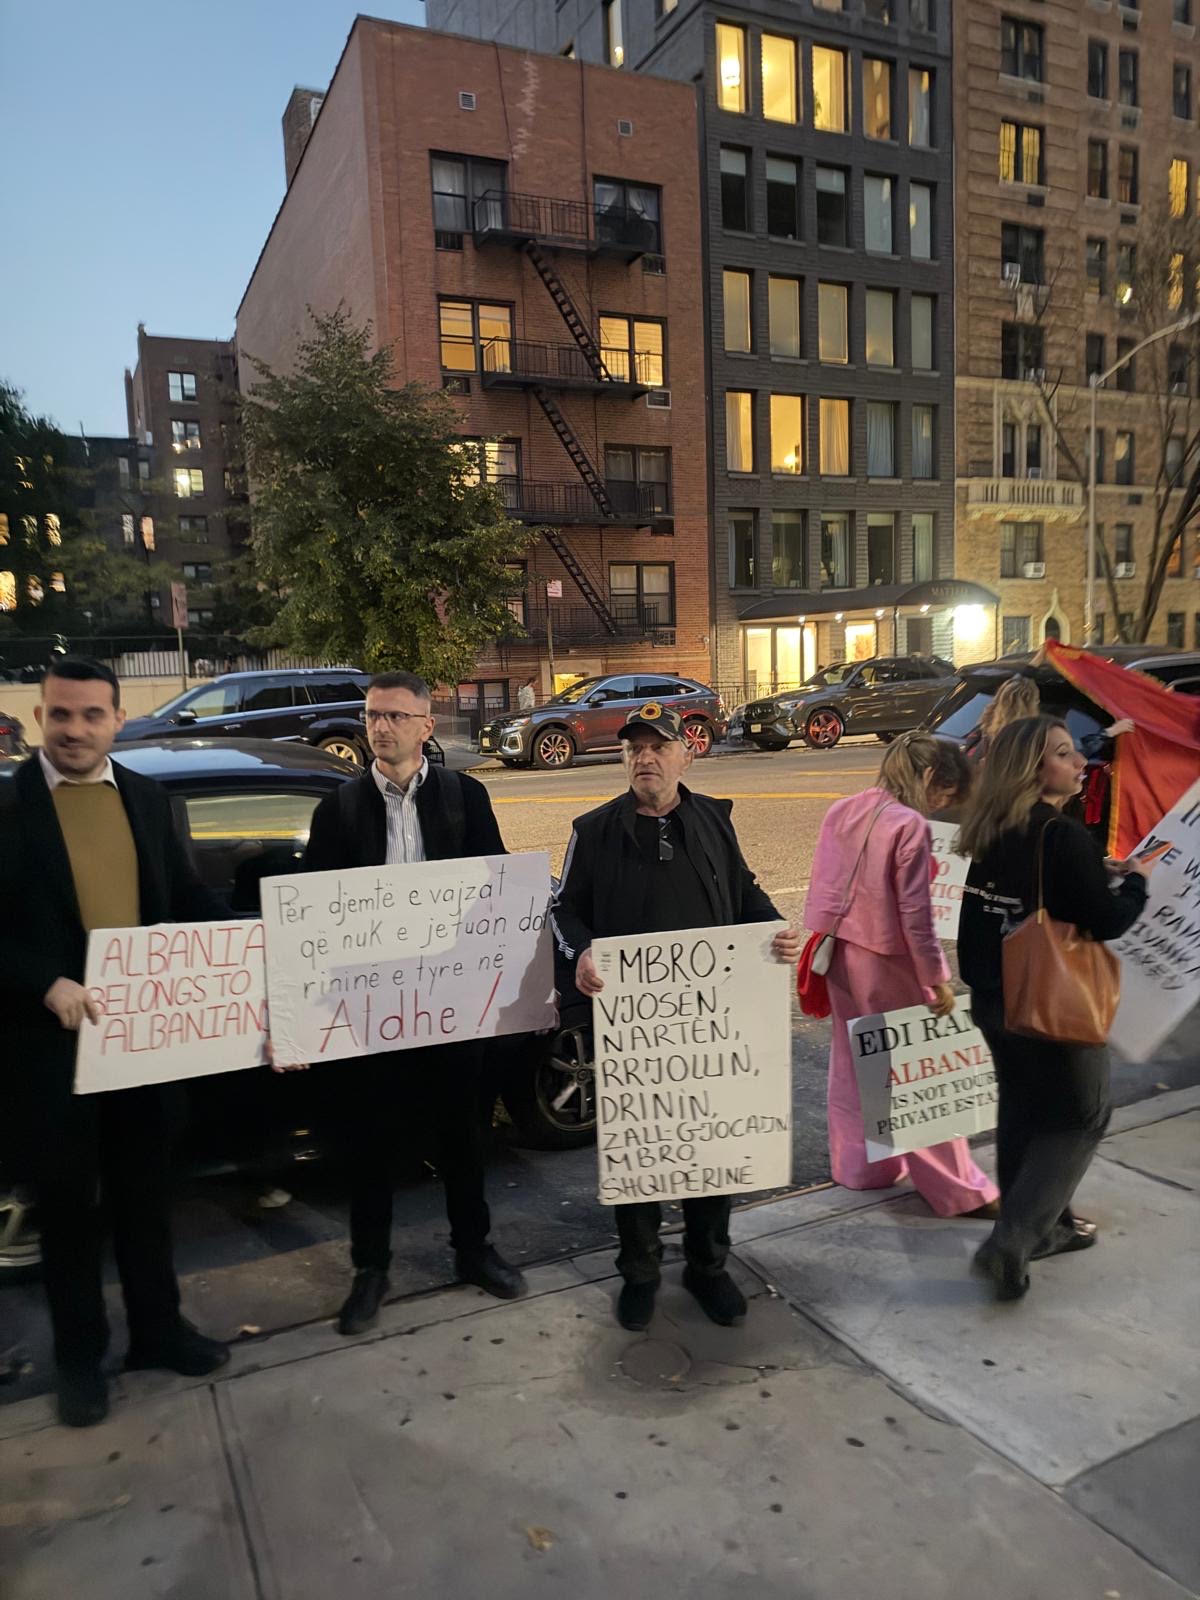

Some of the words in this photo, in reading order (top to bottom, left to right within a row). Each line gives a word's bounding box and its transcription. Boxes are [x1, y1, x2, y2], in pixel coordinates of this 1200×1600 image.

[328, 879, 395, 926] djemtë
[409, 889, 422, 906] e
[429, 863, 507, 917] vajzat
[101, 923, 266, 977] ALBANIA
[301, 930, 328, 970] që
[397, 926, 409, 941] e
[420, 908, 507, 949] jetuan
[619, 940, 735, 984] MBRO:
[88, 975, 207, 1016] BELONGS
[213, 970, 251, 997] TO
[392, 969, 405, 986] e
[416, 954, 463, 996] tyre
[478, 944, 507, 971] në
[319, 988, 457, 1053] Atdhe
[856, 1022, 913, 1057] EDI
[876, 1102, 951, 1135] PRIVATE
[890, 1094, 909, 1110] IS
[912, 1083, 948, 1105] NOT
[605, 1144, 695, 1172] MBRO
